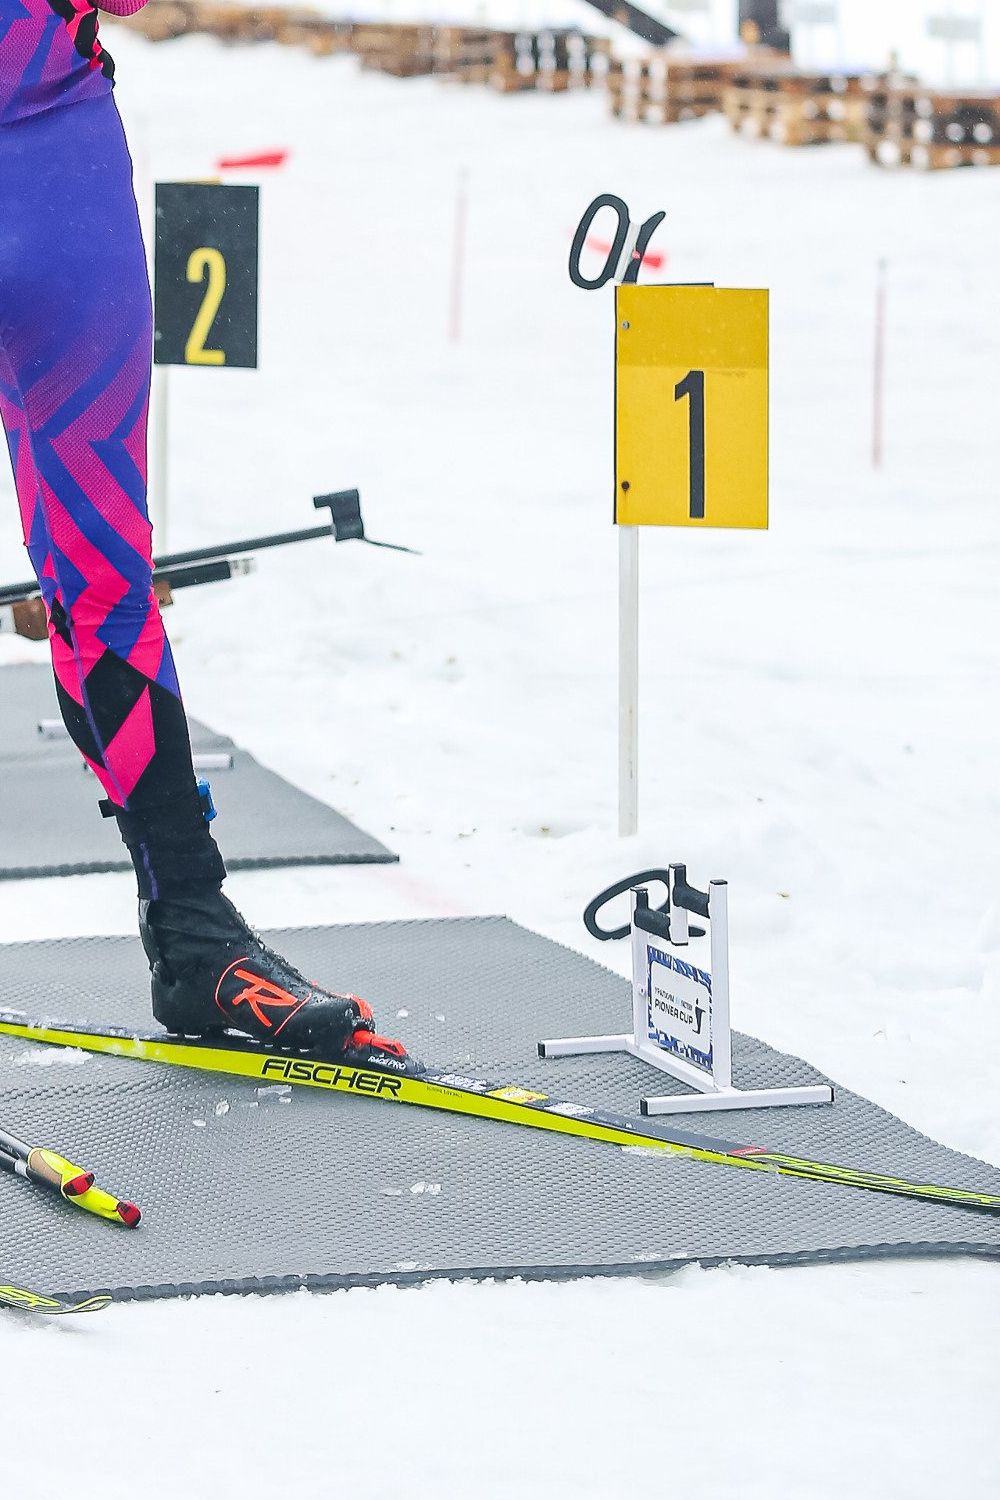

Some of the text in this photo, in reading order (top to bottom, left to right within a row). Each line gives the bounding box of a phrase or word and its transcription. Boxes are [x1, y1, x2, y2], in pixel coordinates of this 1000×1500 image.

[184, 247, 228, 365] 2
[674, 369, 706, 519] 1
[261, 1058, 402, 1097] FISCHER
